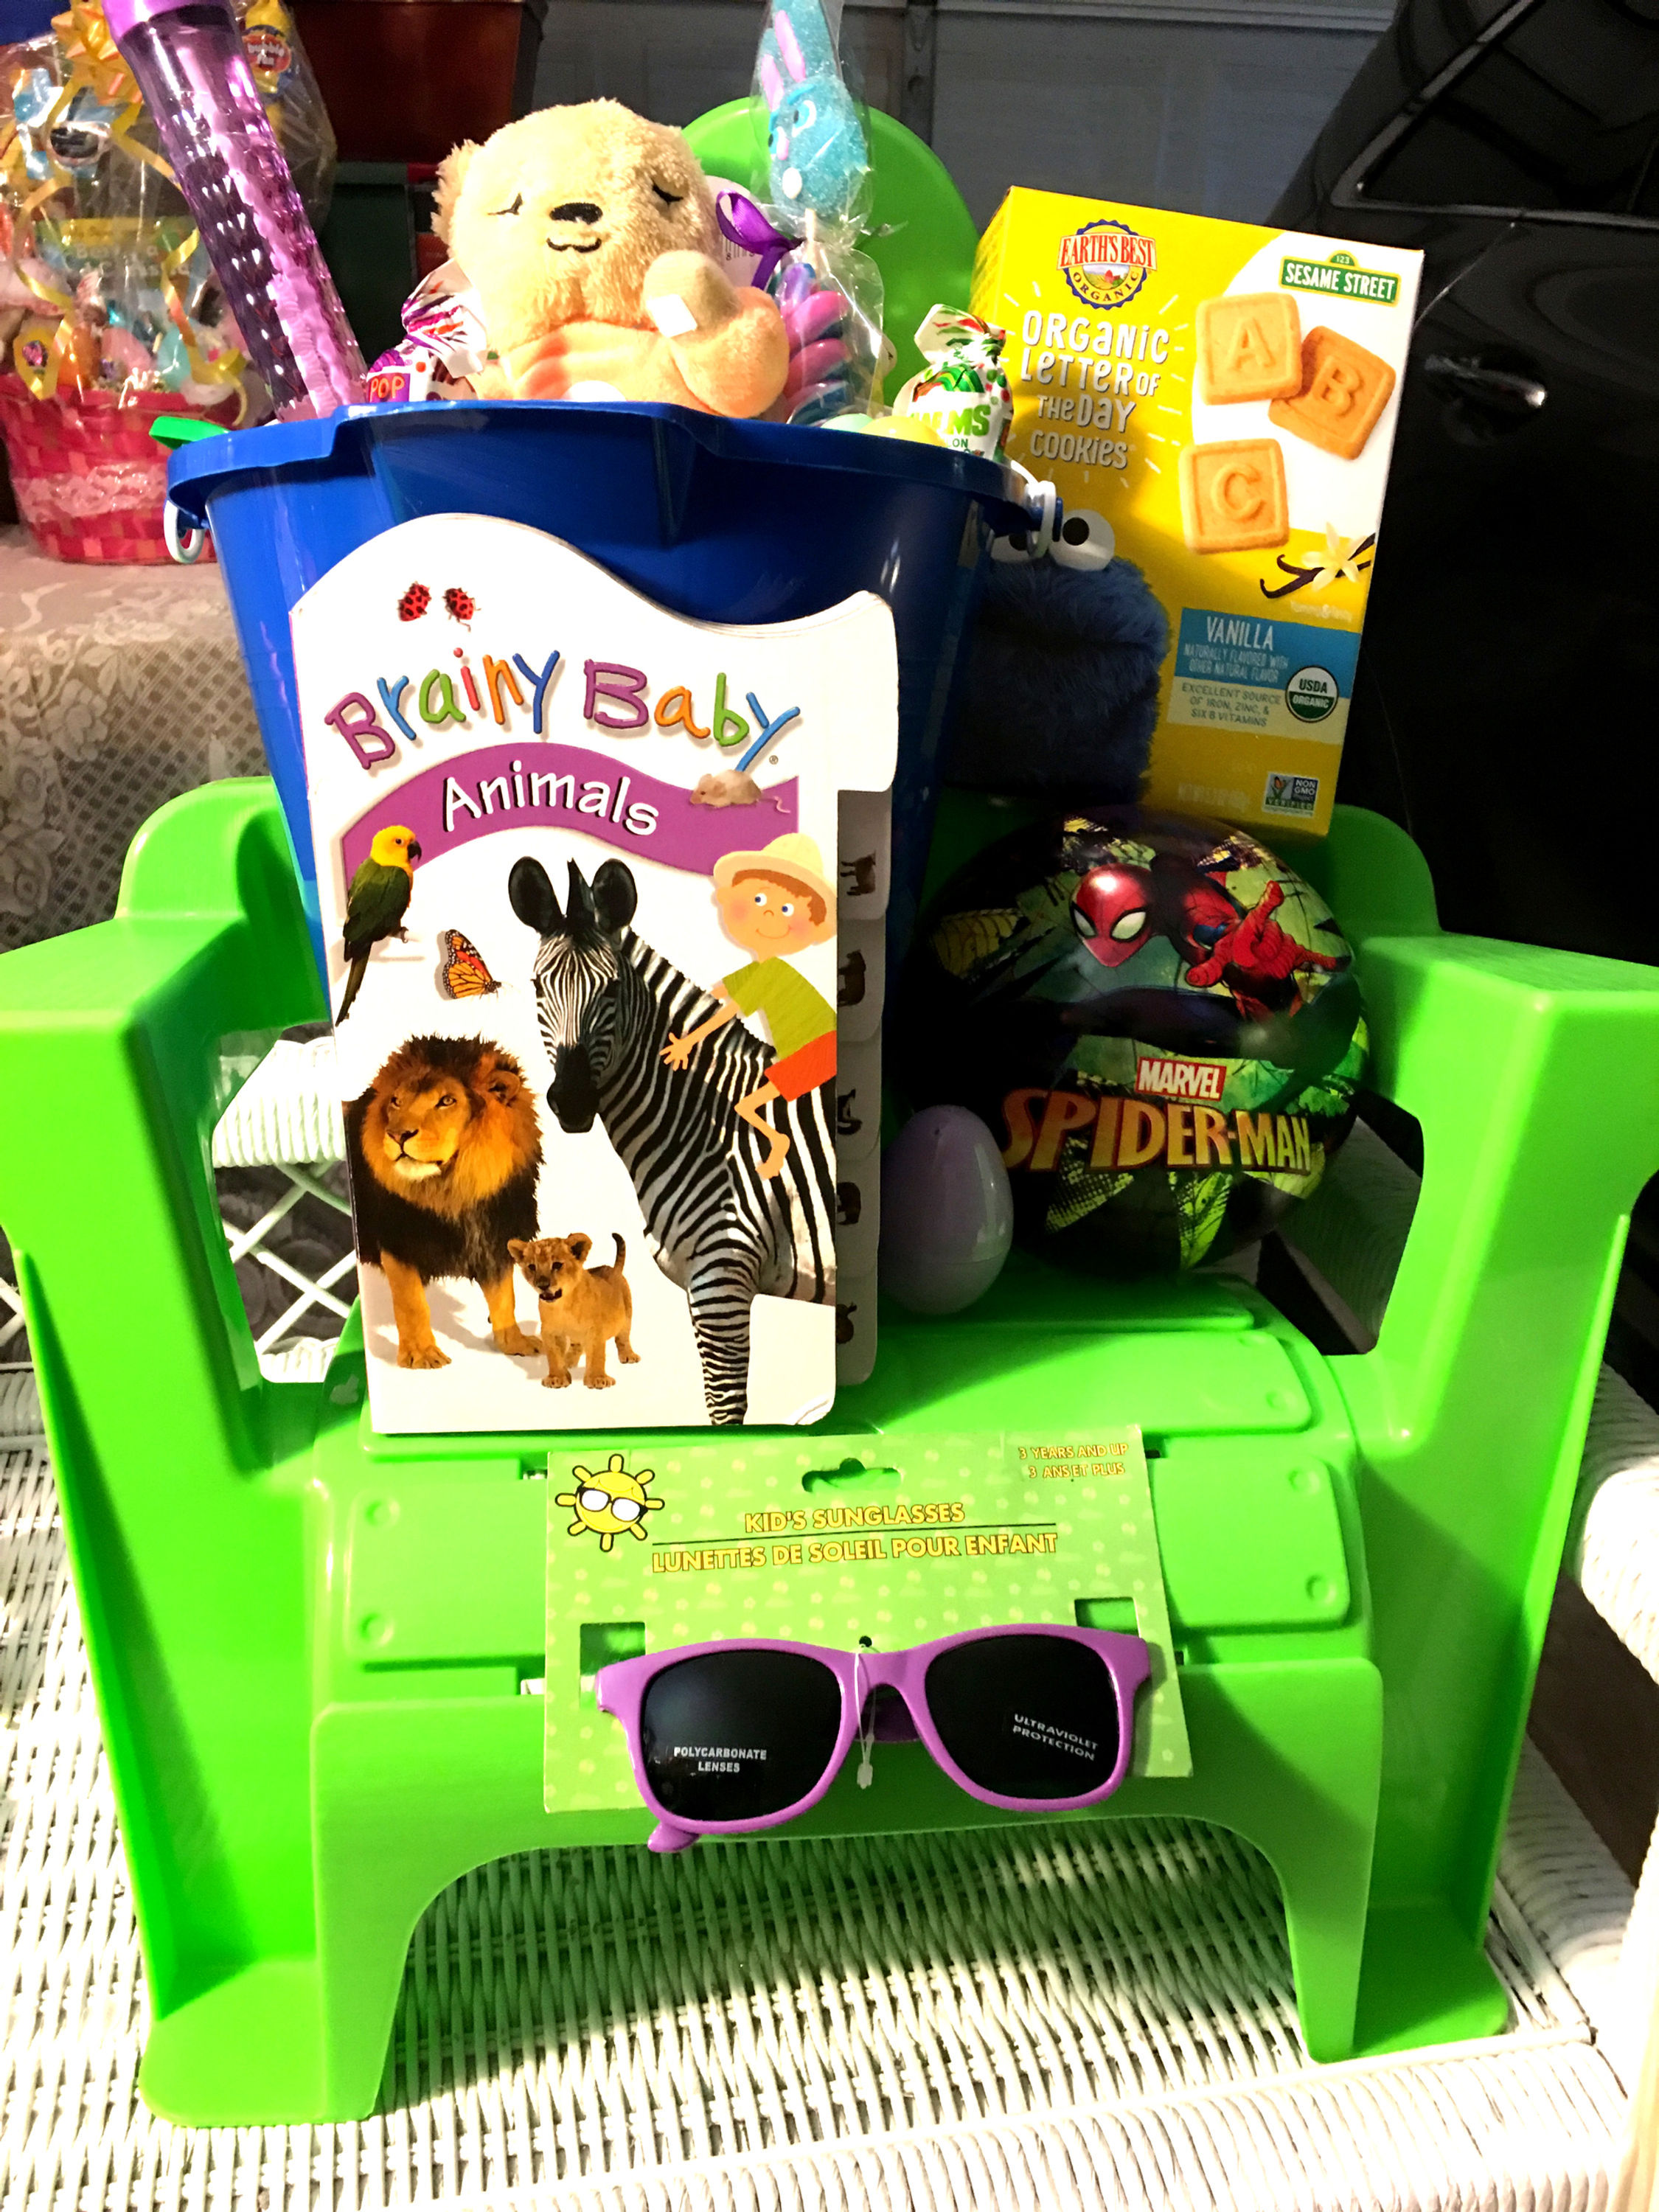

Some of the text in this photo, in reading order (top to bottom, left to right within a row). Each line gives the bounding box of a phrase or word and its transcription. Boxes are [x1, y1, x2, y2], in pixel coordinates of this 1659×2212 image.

[247, 41, 285, 58] bubble
[1060, 234, 1155, 268] EARTH'S BEST
[1335, 255, 1350, 265] 123
[1073, 271, 1140, 302] ORGANIC
[1284, 262, 1395, 300] SESAME STREET
[1225, 316, 1277, 372] A
[369, 375, 405, 403] POP
[1135, 372, 1161, 397] OF
[1311, 355, 1366, 418] B
[1211, 461, 1267, 526] C
[1206, 615, 1274, 651] VANILLA
[1181, 682, 1282, 705] EXCELLENT SOURCE
[1298, 678, 1329, 694] USDA
[324, 648, 801, 772] Brainy Baby
[1189, 695, 1203, 705] OF
[1262, 706, 1270, 715] &
[1292, 694, 1330, 709] ORGANIC
[1191, 708, 1268, 728] SIX B VITAMINS
[442, 759, 659, 836] Animals
[1294, 786, 1316, 796] GMO
[1295, 779, 1316, 788] NON
[1268, 799, 1312, 810] VERIFIED
[1137, 1058, 1222, 1099] MARVEL
[1002, 1087, 1311, 1175] SPIDER-MAN
[1018, 1442, 1129, 1460] 3 YEARS AND UP
[1029, 1462, 1125, 1478] 3 ANS ET PLUS
[745, 1501, 966, 1534] KID'S SUNGLASSES
[652, 1532, 1058, 1573] LUNETTES DE SOLEIL POUR ENFANT
[1012, 1724, 1096, 1761] PROTECTION
[1014, 1713, 1099, 1751] ULTRAVIOLET
[673, 1746, 768, 1761] POLYCARBONATE
[698, 1761, 740, 1773] LENSES
